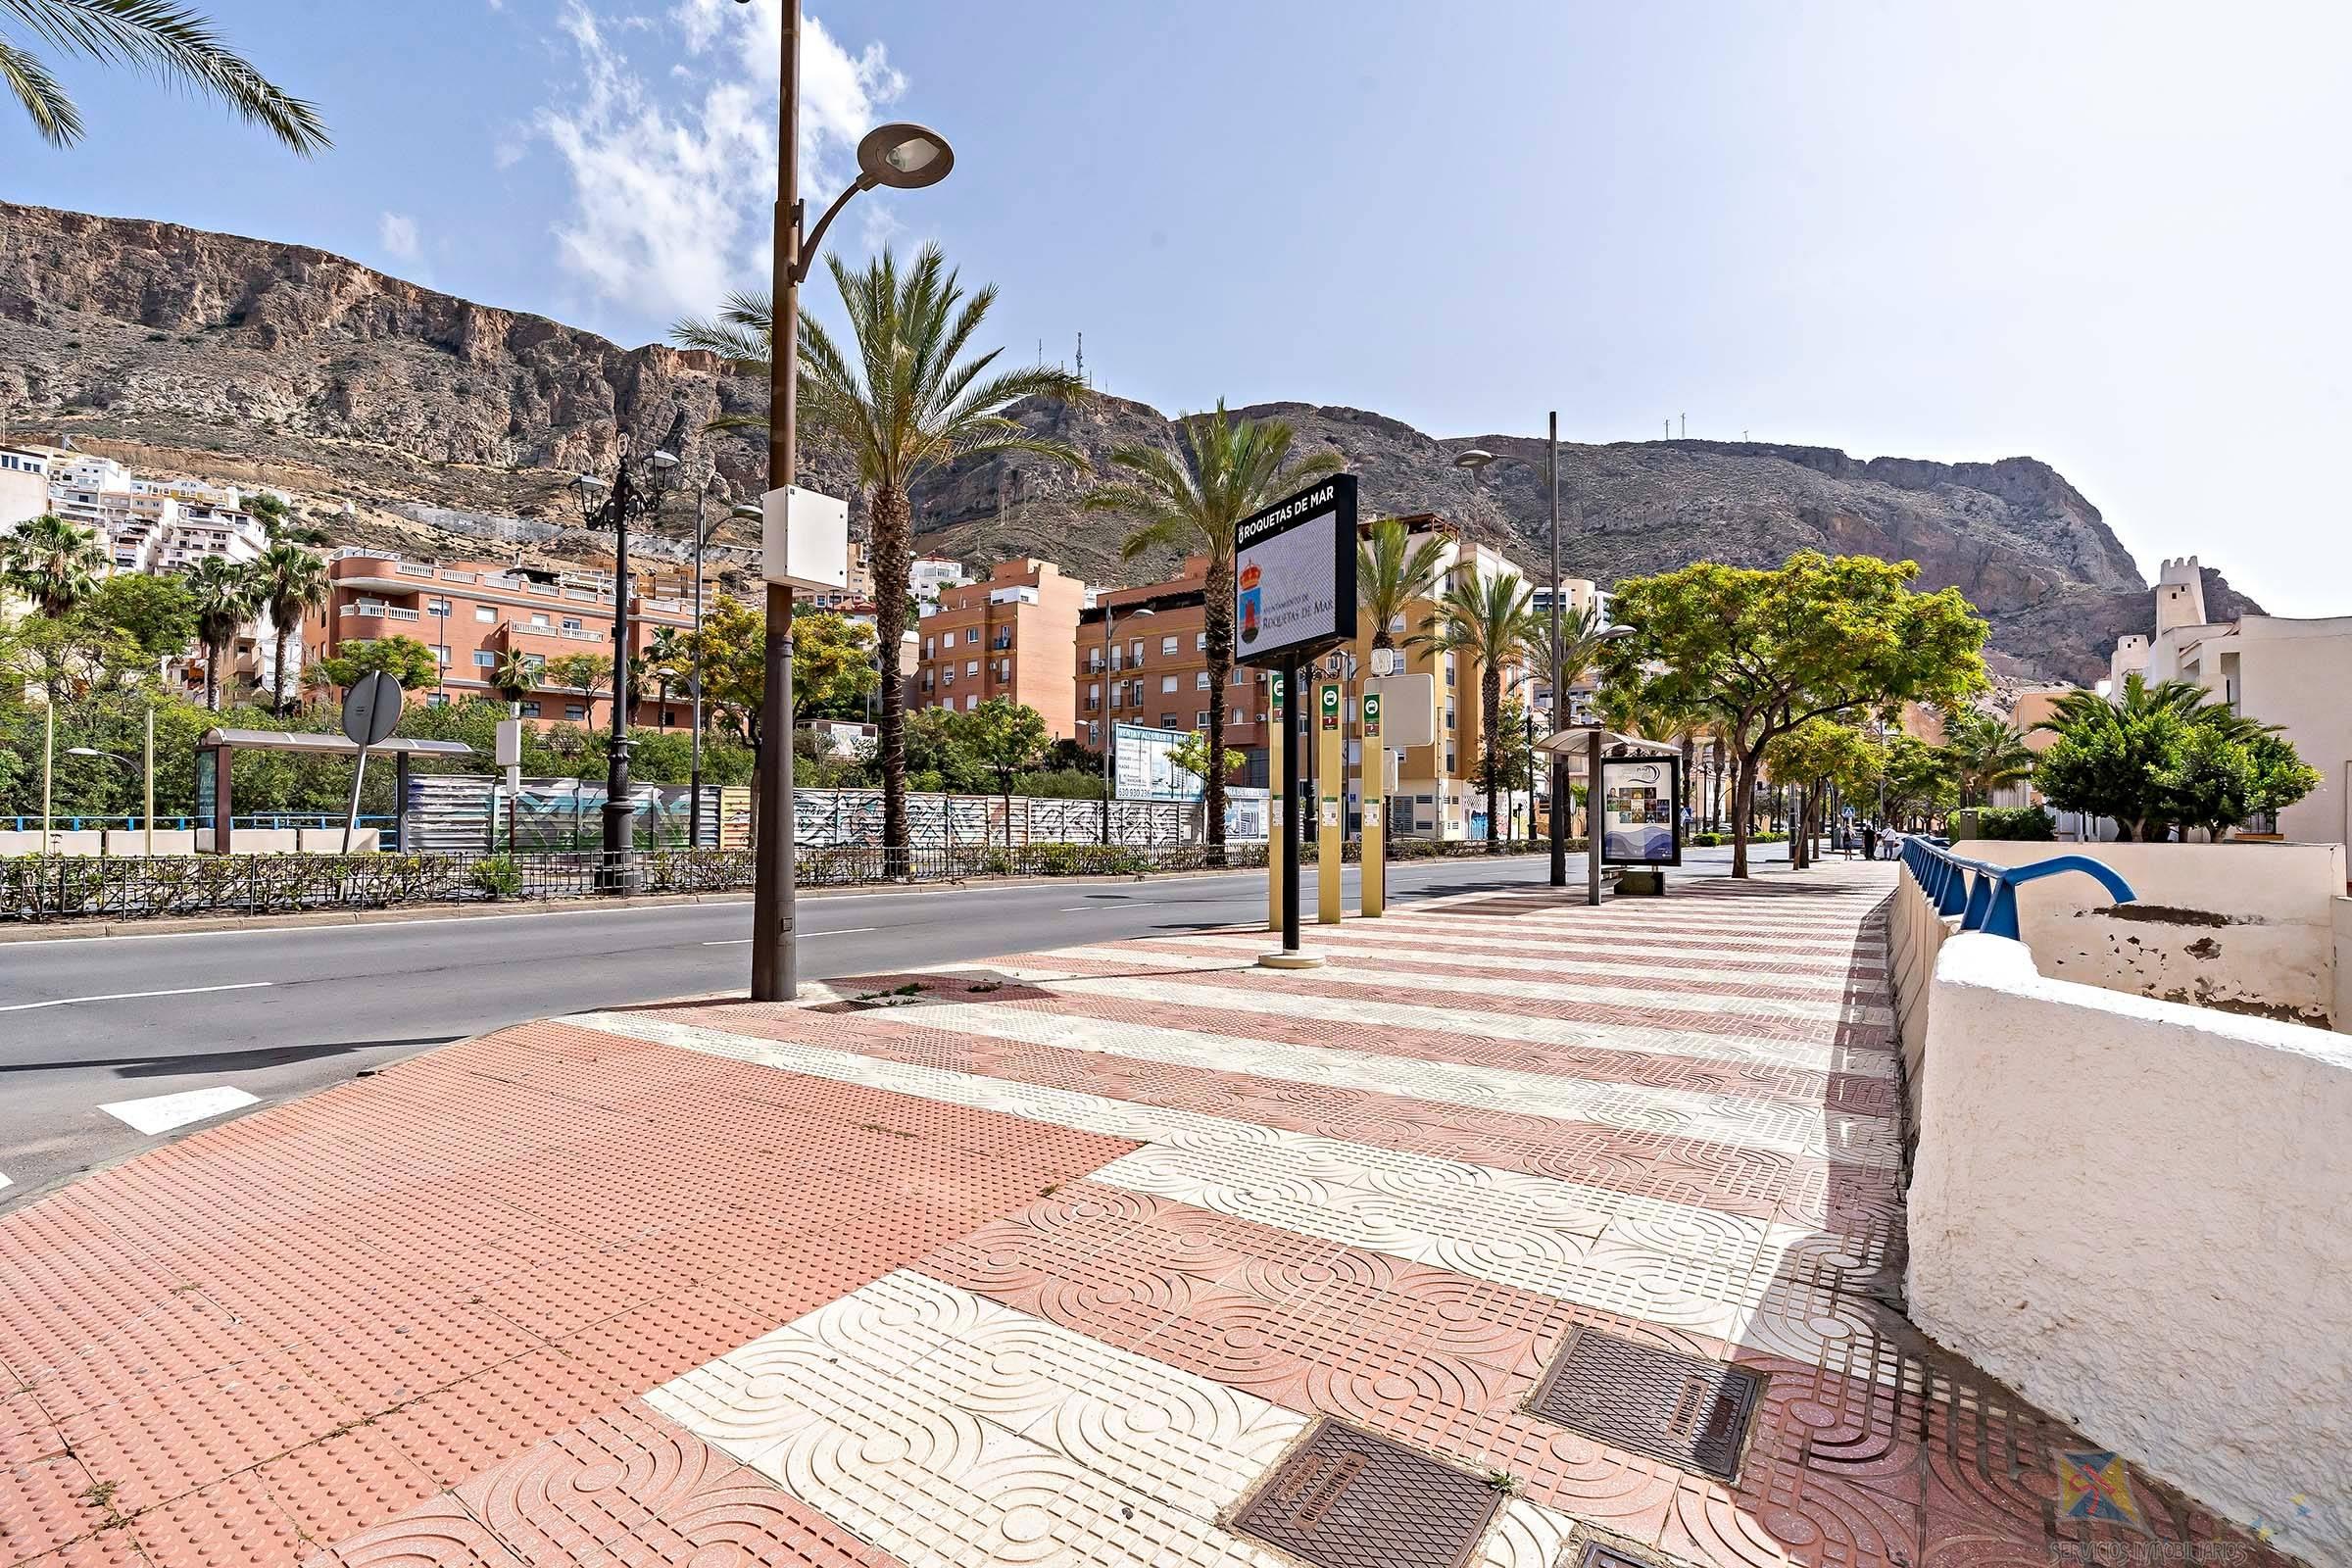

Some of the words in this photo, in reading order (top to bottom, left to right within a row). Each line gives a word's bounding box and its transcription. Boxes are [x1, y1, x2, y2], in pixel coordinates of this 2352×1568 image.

[1245, 505, 1293, 539] ROQUETAS
[1295, 497, 1308, 515] DE
[1310, 485, 1334, 509] MAR
[1263, 611, 1299, 630] ROQUETAS
[1301, 606, 1312, 618] DE
[1314, 599, 1334, 615] MAR
[1118, 787, 1129, 797] 630
[1130, 788, 1140, 797] 930
[1671, 1383, 1703, 1437] ALUMBRADO
[1300, 1458, 1360, 1522] ALUMBRADO
